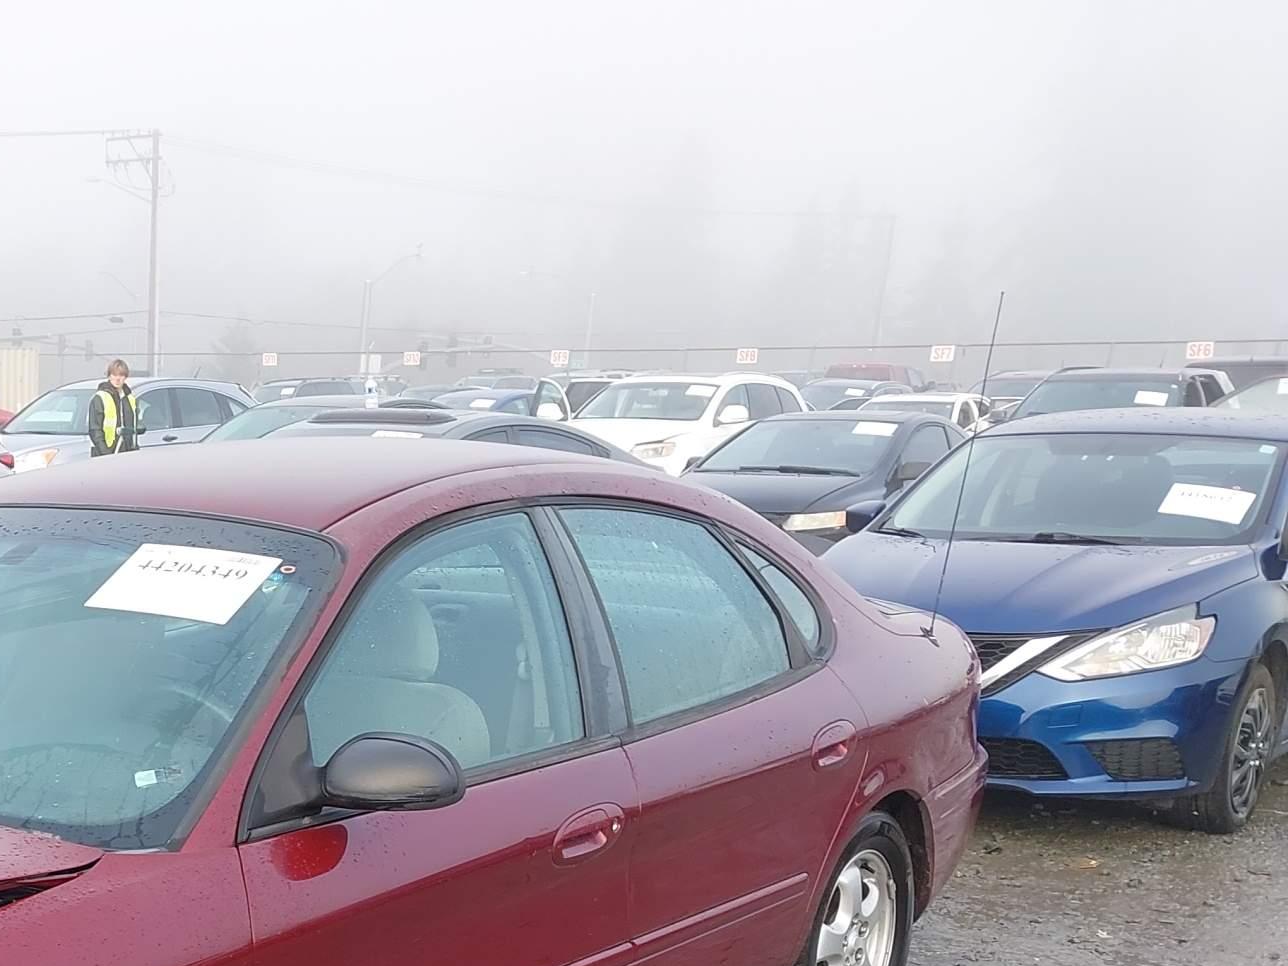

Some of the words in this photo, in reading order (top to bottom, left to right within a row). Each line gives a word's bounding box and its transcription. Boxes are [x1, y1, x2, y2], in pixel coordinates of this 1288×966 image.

[933, 347, 953, 360] SF7
[1188, 343, 1212, 357] SF6
[137, 559, 249, 581] 44204349
